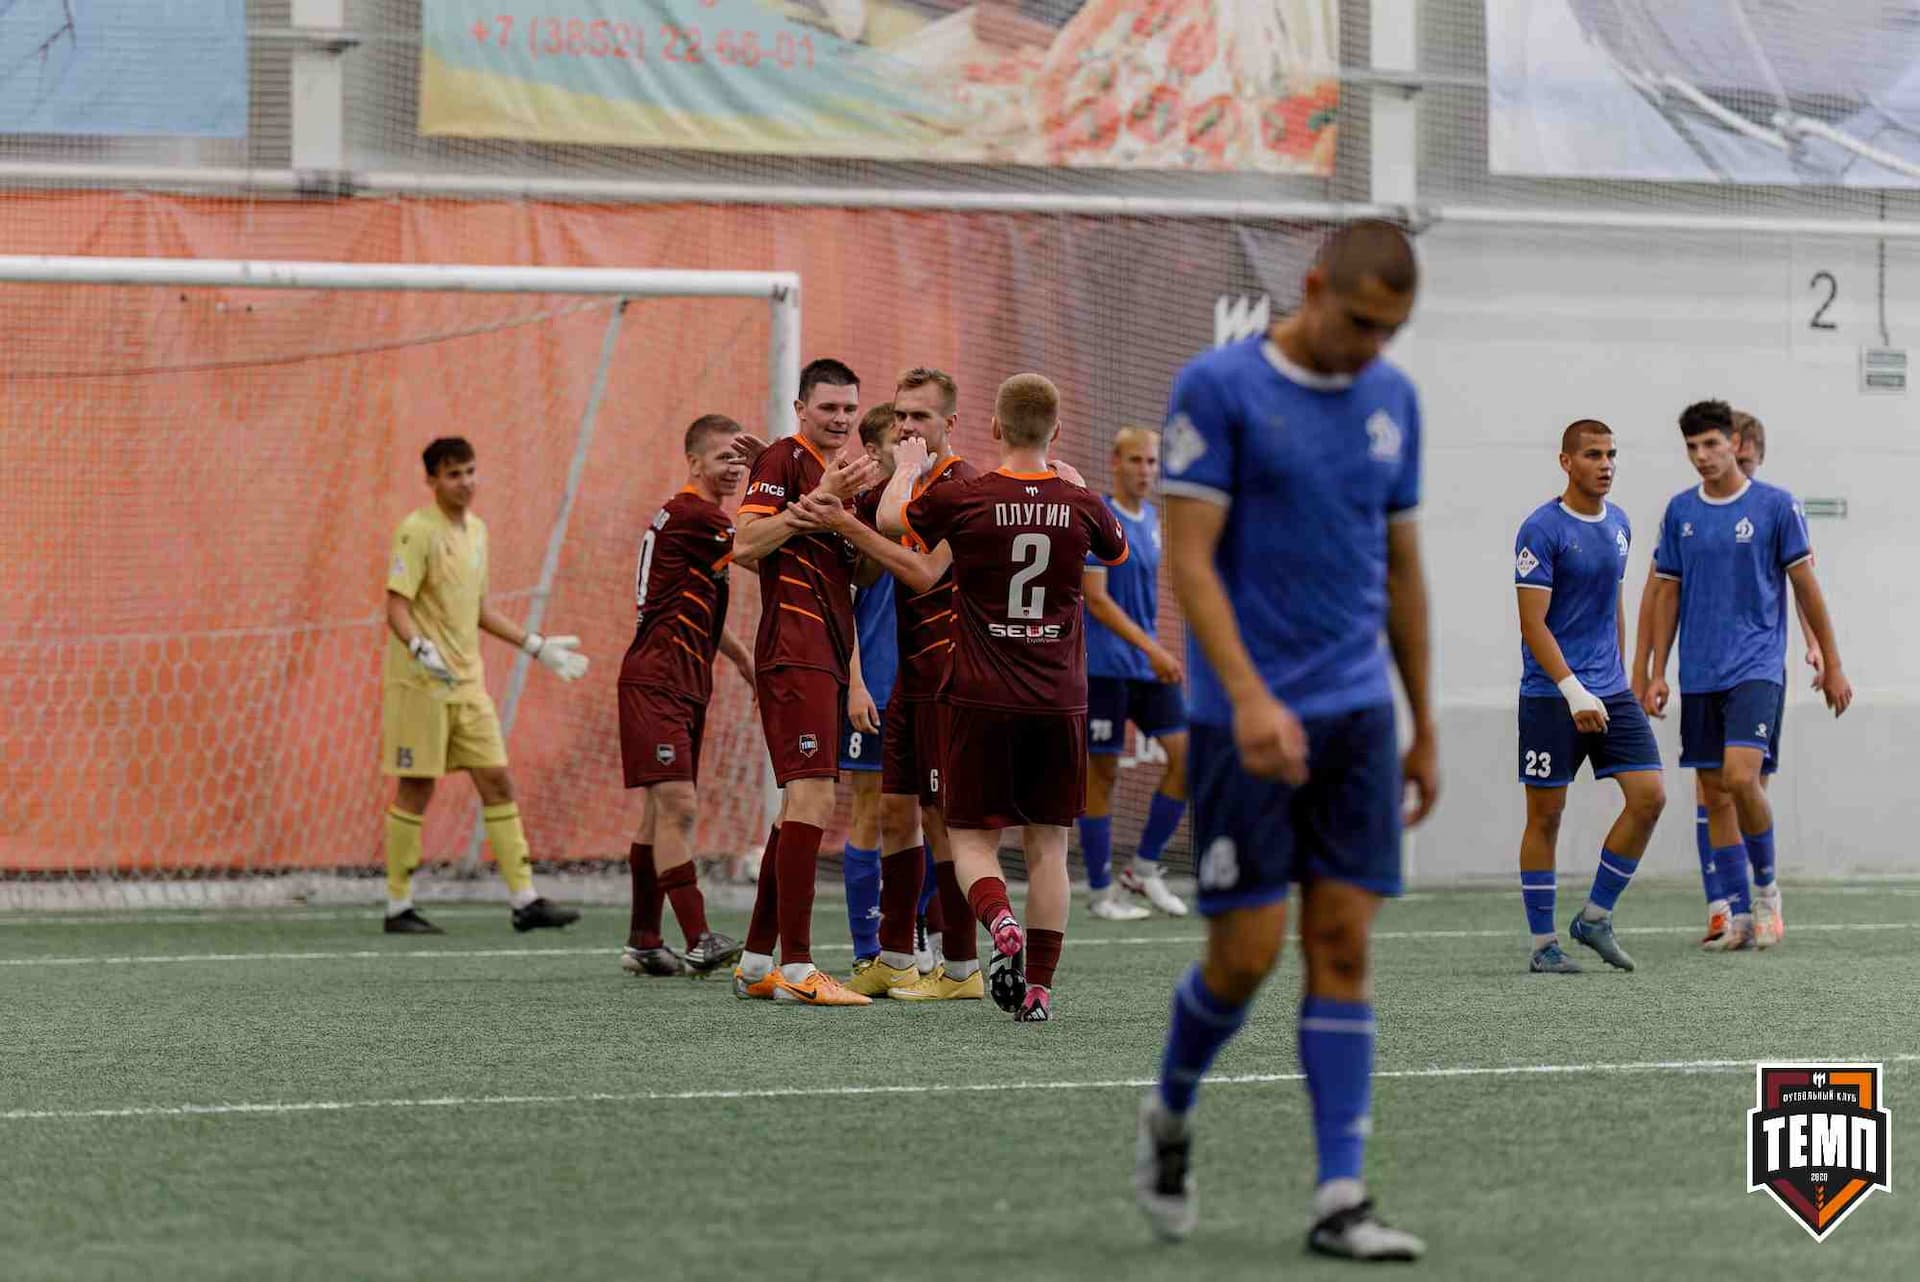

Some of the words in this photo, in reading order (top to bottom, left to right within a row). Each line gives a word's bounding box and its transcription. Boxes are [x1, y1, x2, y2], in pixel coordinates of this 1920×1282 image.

[471, 15, 513, 47] +7
[529, 16, 644, 60] (3852)
[660, 24, 815, 69] 22-66-01
[1810, 271, 1838, 330] 2
[759, 483, 785, 497] ПСБ
[995, 503, 1070, 528] ПЛУГИН
[1008, 532, 1051, 619] 2
[988, 623, 1061, 638] SEUS
[848, 732, 862, 759] 8
[1524, 749, 1553, 779] 23
[930, 768, 939, 793] 6
